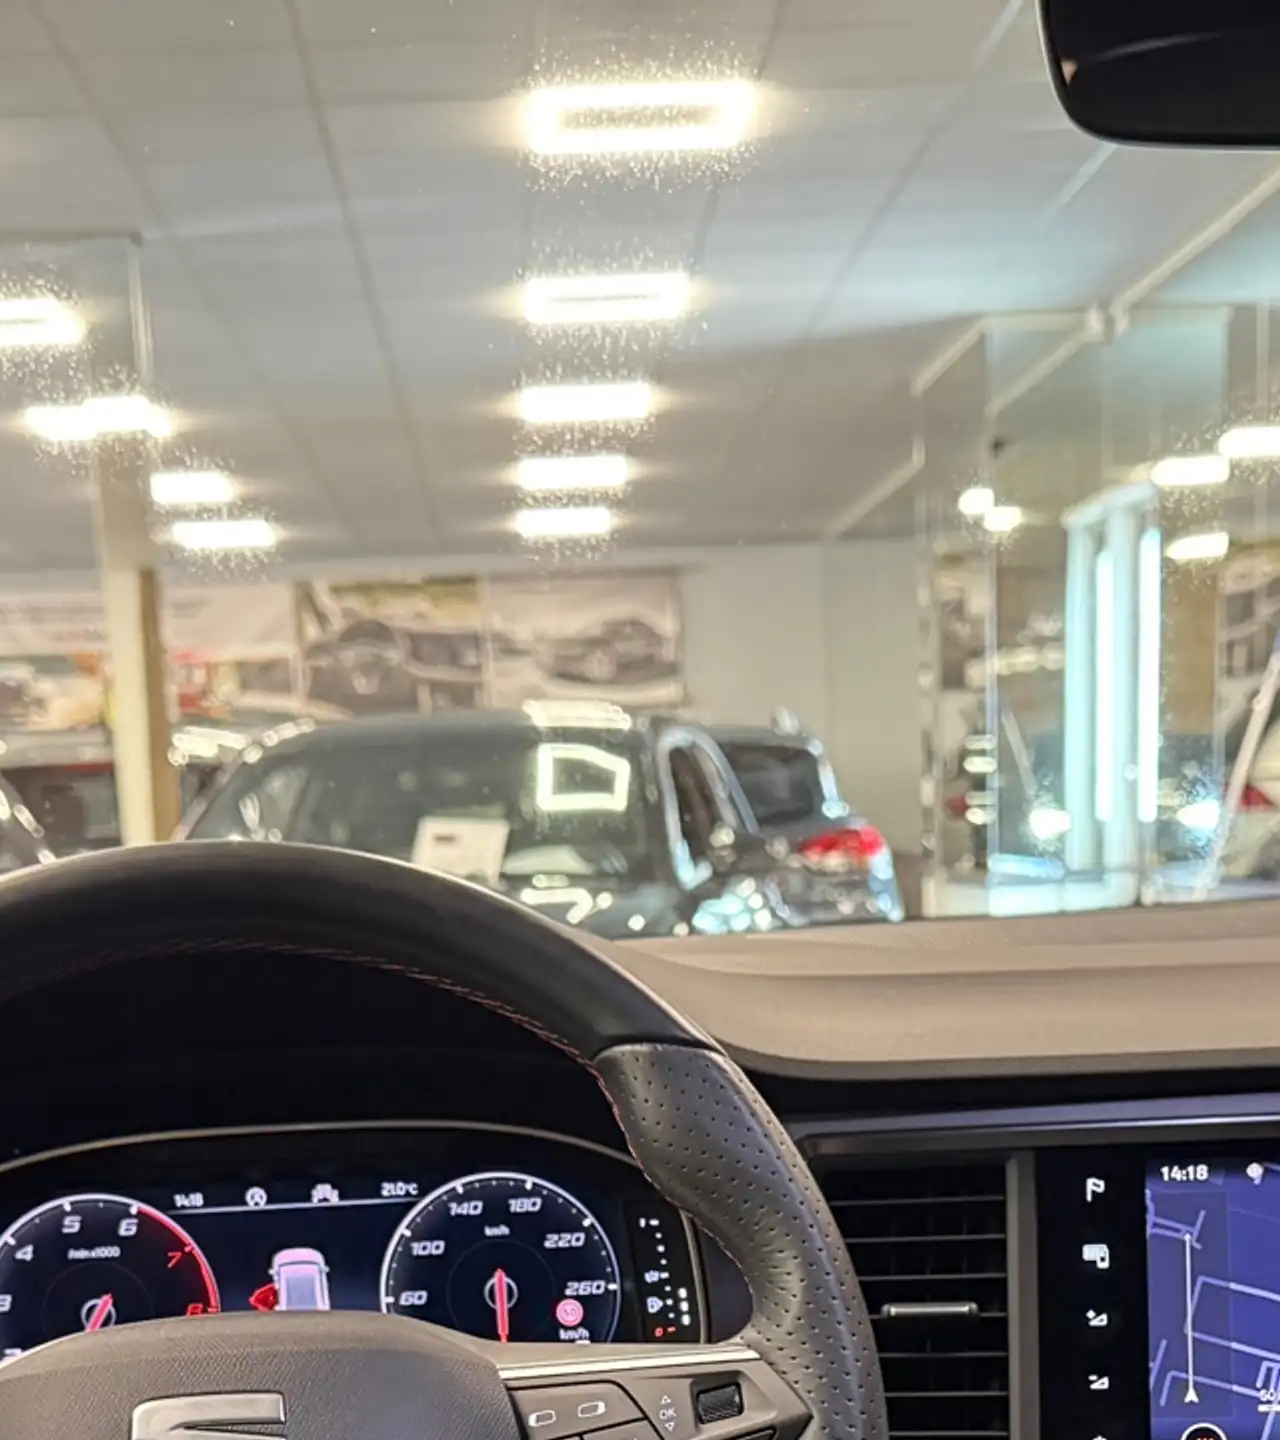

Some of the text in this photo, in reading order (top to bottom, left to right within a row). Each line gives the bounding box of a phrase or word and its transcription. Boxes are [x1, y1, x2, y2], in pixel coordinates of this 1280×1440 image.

[1160, 1164, 1210, 1182] 14:18
[448, 1200, 483, 1217] 140
[508, 1197, 542, 1214] 180
[61, 1215, 82, 1234] 5
[118, 1218, 139, 1236] 6
[484, 1225, 510, 1237] km/h
[410, 1239, 445, 1256] 100
[543, 1231, 587, 1249] 220
[15, 1244, 33, 1262] 4
[166, 1252, 182, 1269] 7
[564, 1279, 607, 1296] 260
[399, 1290, 428, 1307] 60
[558, 1326, 591, 1341] km/h
[1259, 1389, 1277, 1402] 50
[658, 1406, 677, 1421] OK
